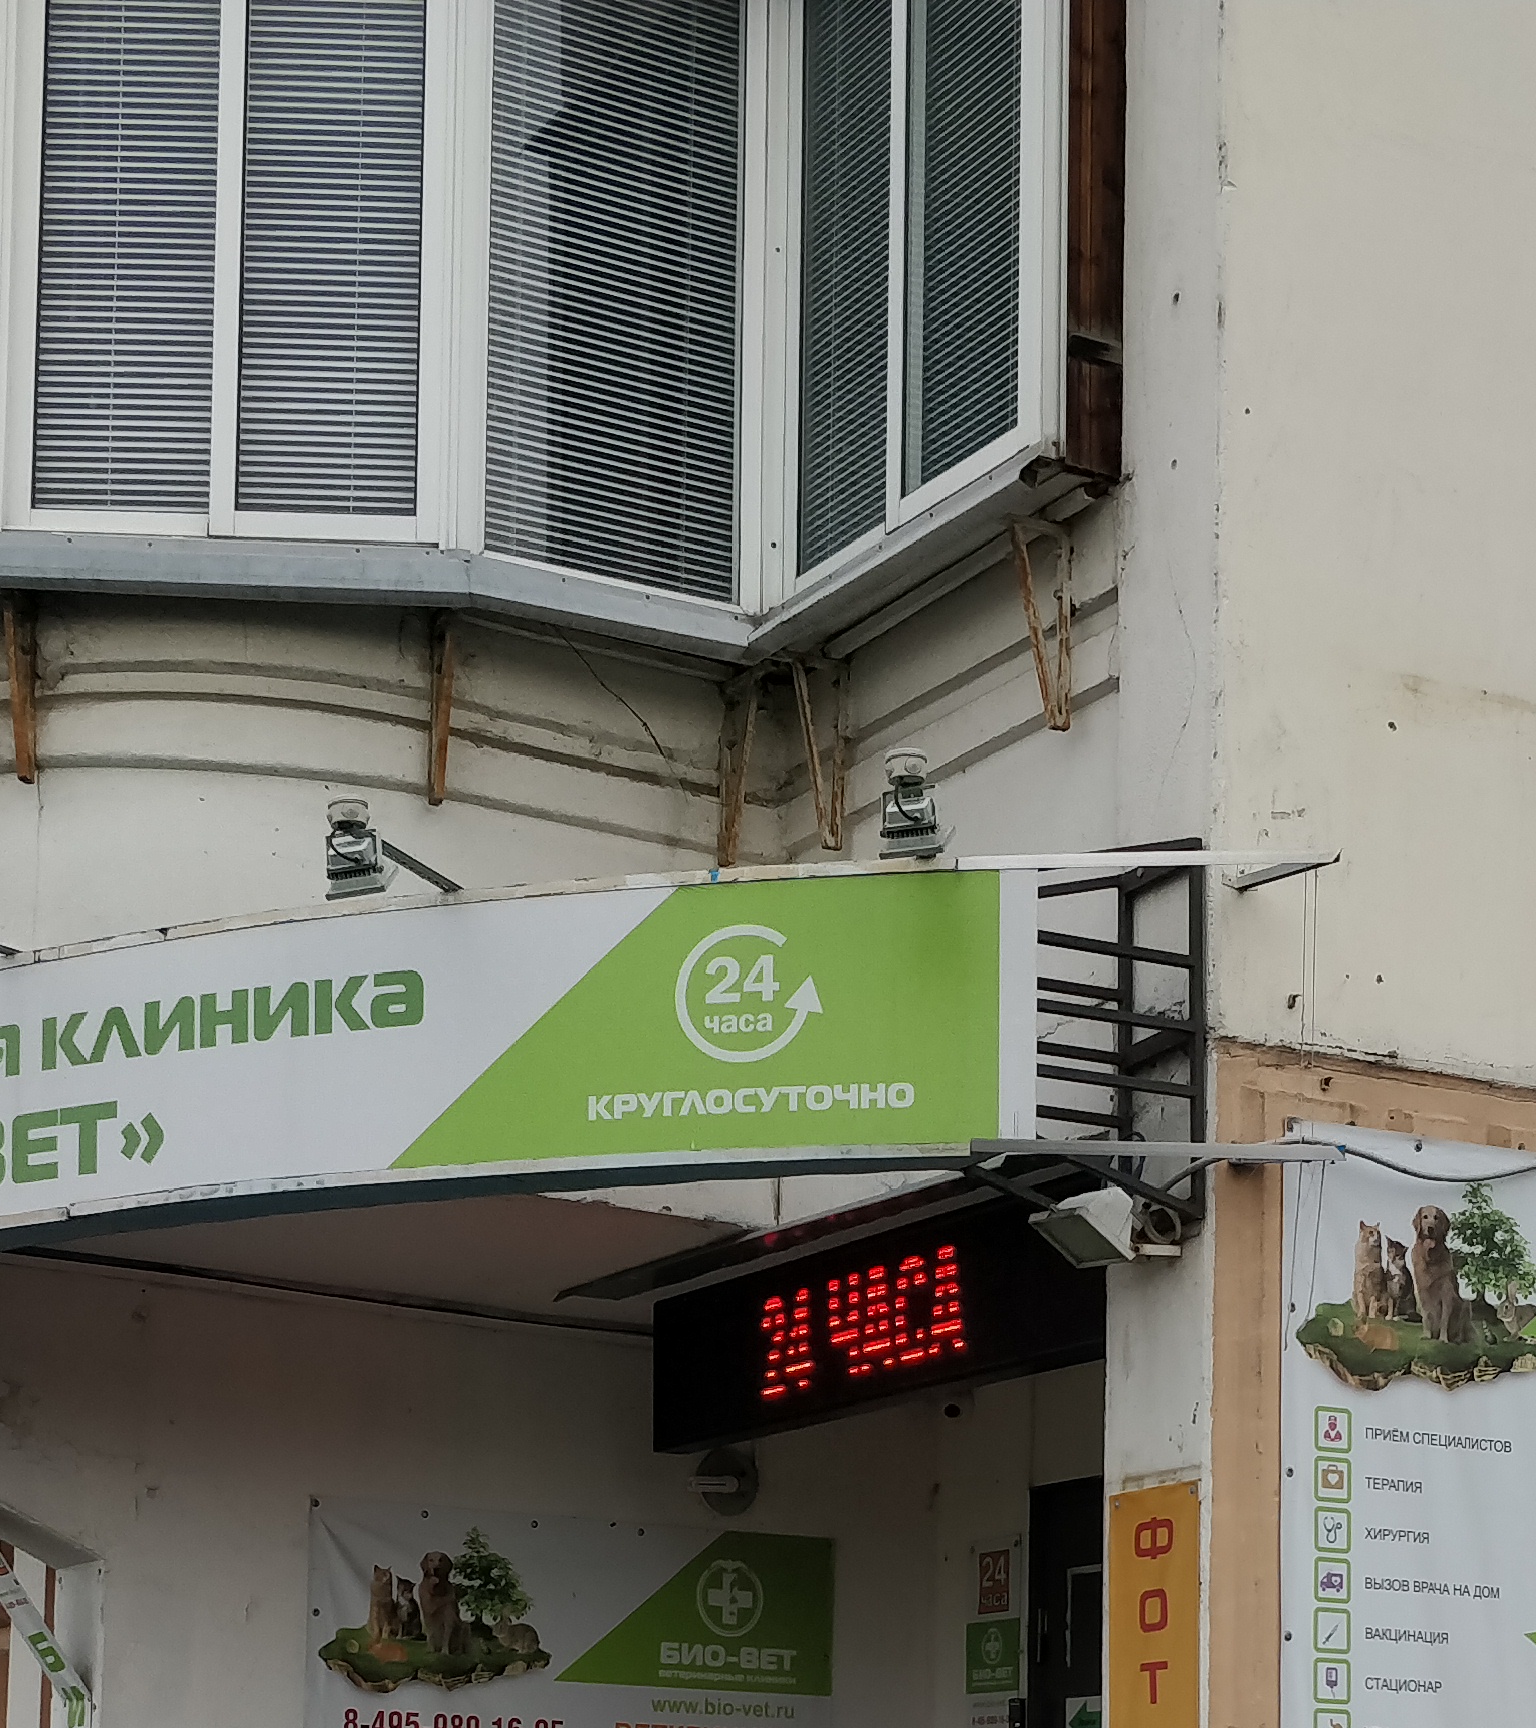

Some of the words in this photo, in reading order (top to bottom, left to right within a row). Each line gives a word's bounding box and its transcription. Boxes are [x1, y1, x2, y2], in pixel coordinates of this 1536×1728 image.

[705, 955, 780, 1004] 24
[41, 970, 424, 1072] клиника
[704, 1012, 773, 1034] часа
[587, 1082, 915, 1121] КРУГЛОСУТОЧНО
[826, 1244, 967, 1377] ЧАСА
[1364, 1426, 1410, 1444] ПРИЁМ
[1412, 1431, 1513, 1453] СПЕЦИАЛИСТОВ
[1364, 1477, 1423, 1495] ТЕРАПИЯ
[1364, 1527, 1430, 1545] ХИРУРГИЯ
[981, 1556, 1008, 1588] 24
[981, 1591, 1009, 1607] часа
[1364, 1577, 1410, 1593] ВЫЗОВ
[1412, 1579, 1451, 1596] ВРАЧА
[1453, 1581, 1471, 1597] НА
[1473, 1583, 1501, 1600] ДОМ
[1364, 1628, 1450, 1646] ВАКЦИНАЦИЯ
[659, 1642, 797, 1672] БИО-ВЕТ
[1364, 1677, 1443, 1694] СТАЦИОНАР
[651, 1697, 796, 1720] www.bio-vet.ru
